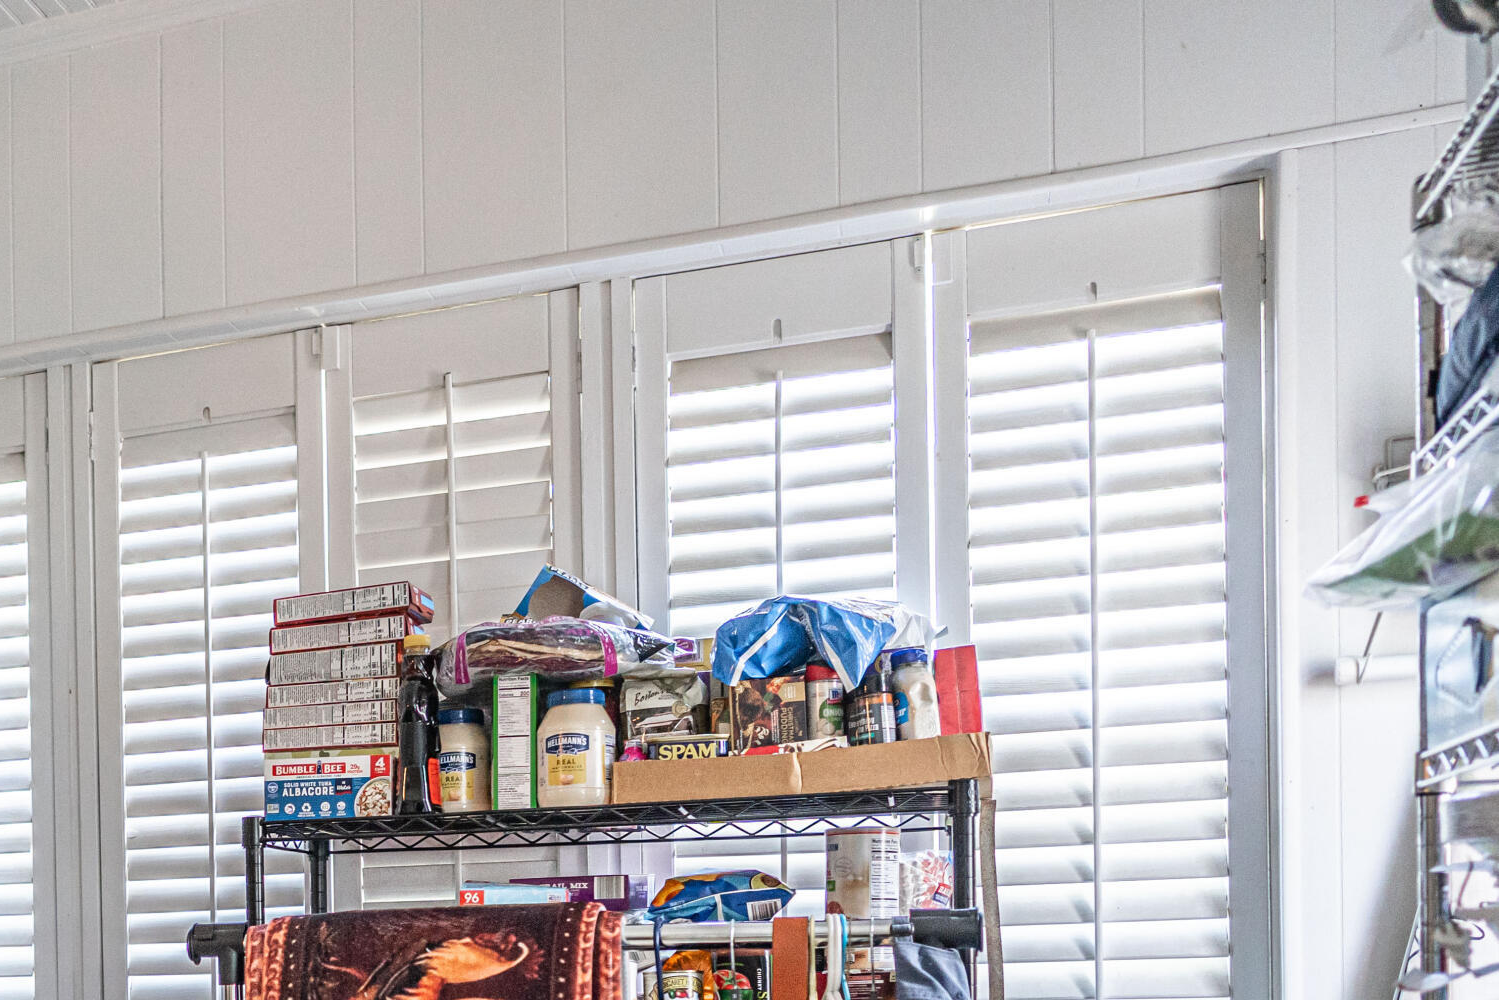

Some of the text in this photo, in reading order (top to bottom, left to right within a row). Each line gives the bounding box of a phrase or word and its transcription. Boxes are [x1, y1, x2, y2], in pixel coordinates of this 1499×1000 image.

[547, 735, 588, 746] HELLMANN'S
[658, 742, 717, 760] SPAM
[375, 757, 385, 768] 4
[439, 753, 474, 764] ELLMANN'S
[275, 762, 344, 776] BUMBLE BEE
[282, 786, 335, 797] ALBACORE
[464, 892, 480, 904] 96
